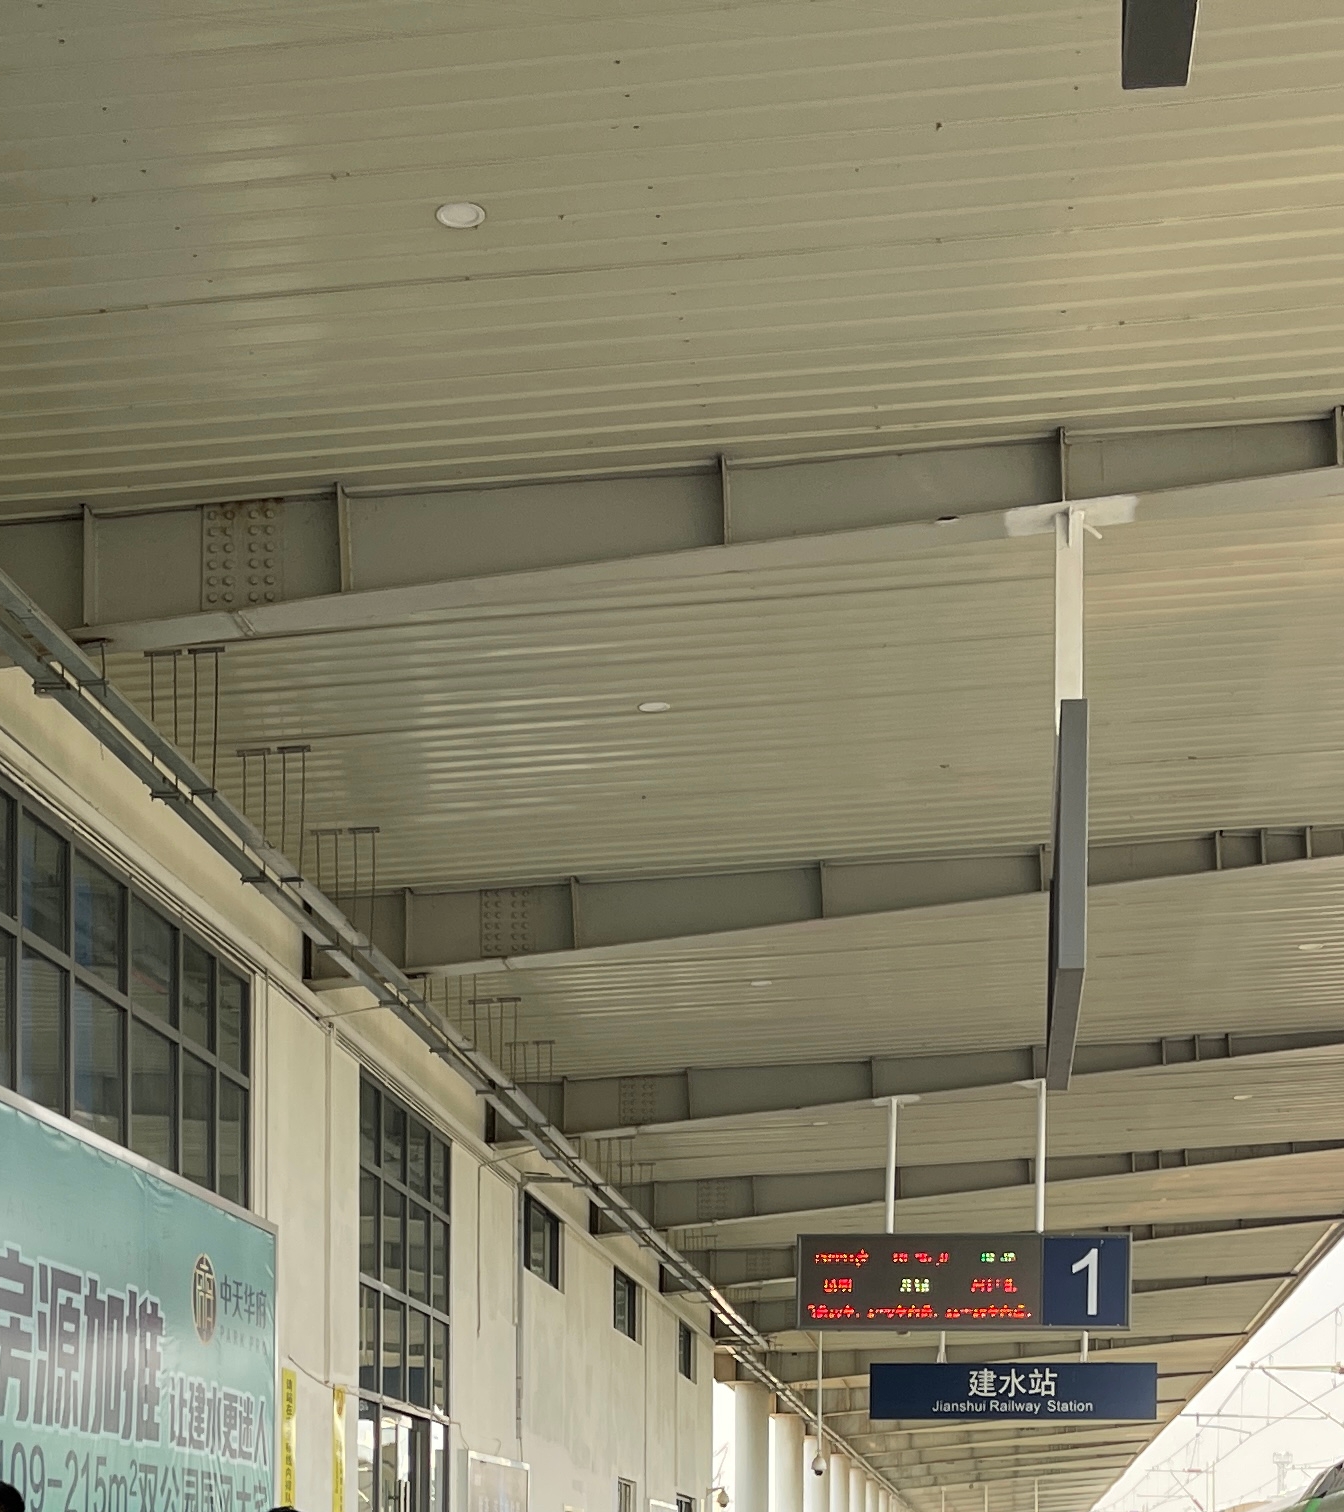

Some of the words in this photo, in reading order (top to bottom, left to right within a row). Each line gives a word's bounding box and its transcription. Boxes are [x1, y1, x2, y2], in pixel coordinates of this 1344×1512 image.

[219, 1273, 268, 1330] 中天华府
[1071, 1248, 1099, 1316] 1
[932, 1399, 987, 1413] Jianshui
[989, 1399, 1041, 1415] Railway
[1047, 1399, 1093, 1412] Station
[968, 1368, 1059, 1397] 建水站
[169, 1373, 269, 1468] 让建水更迷人
